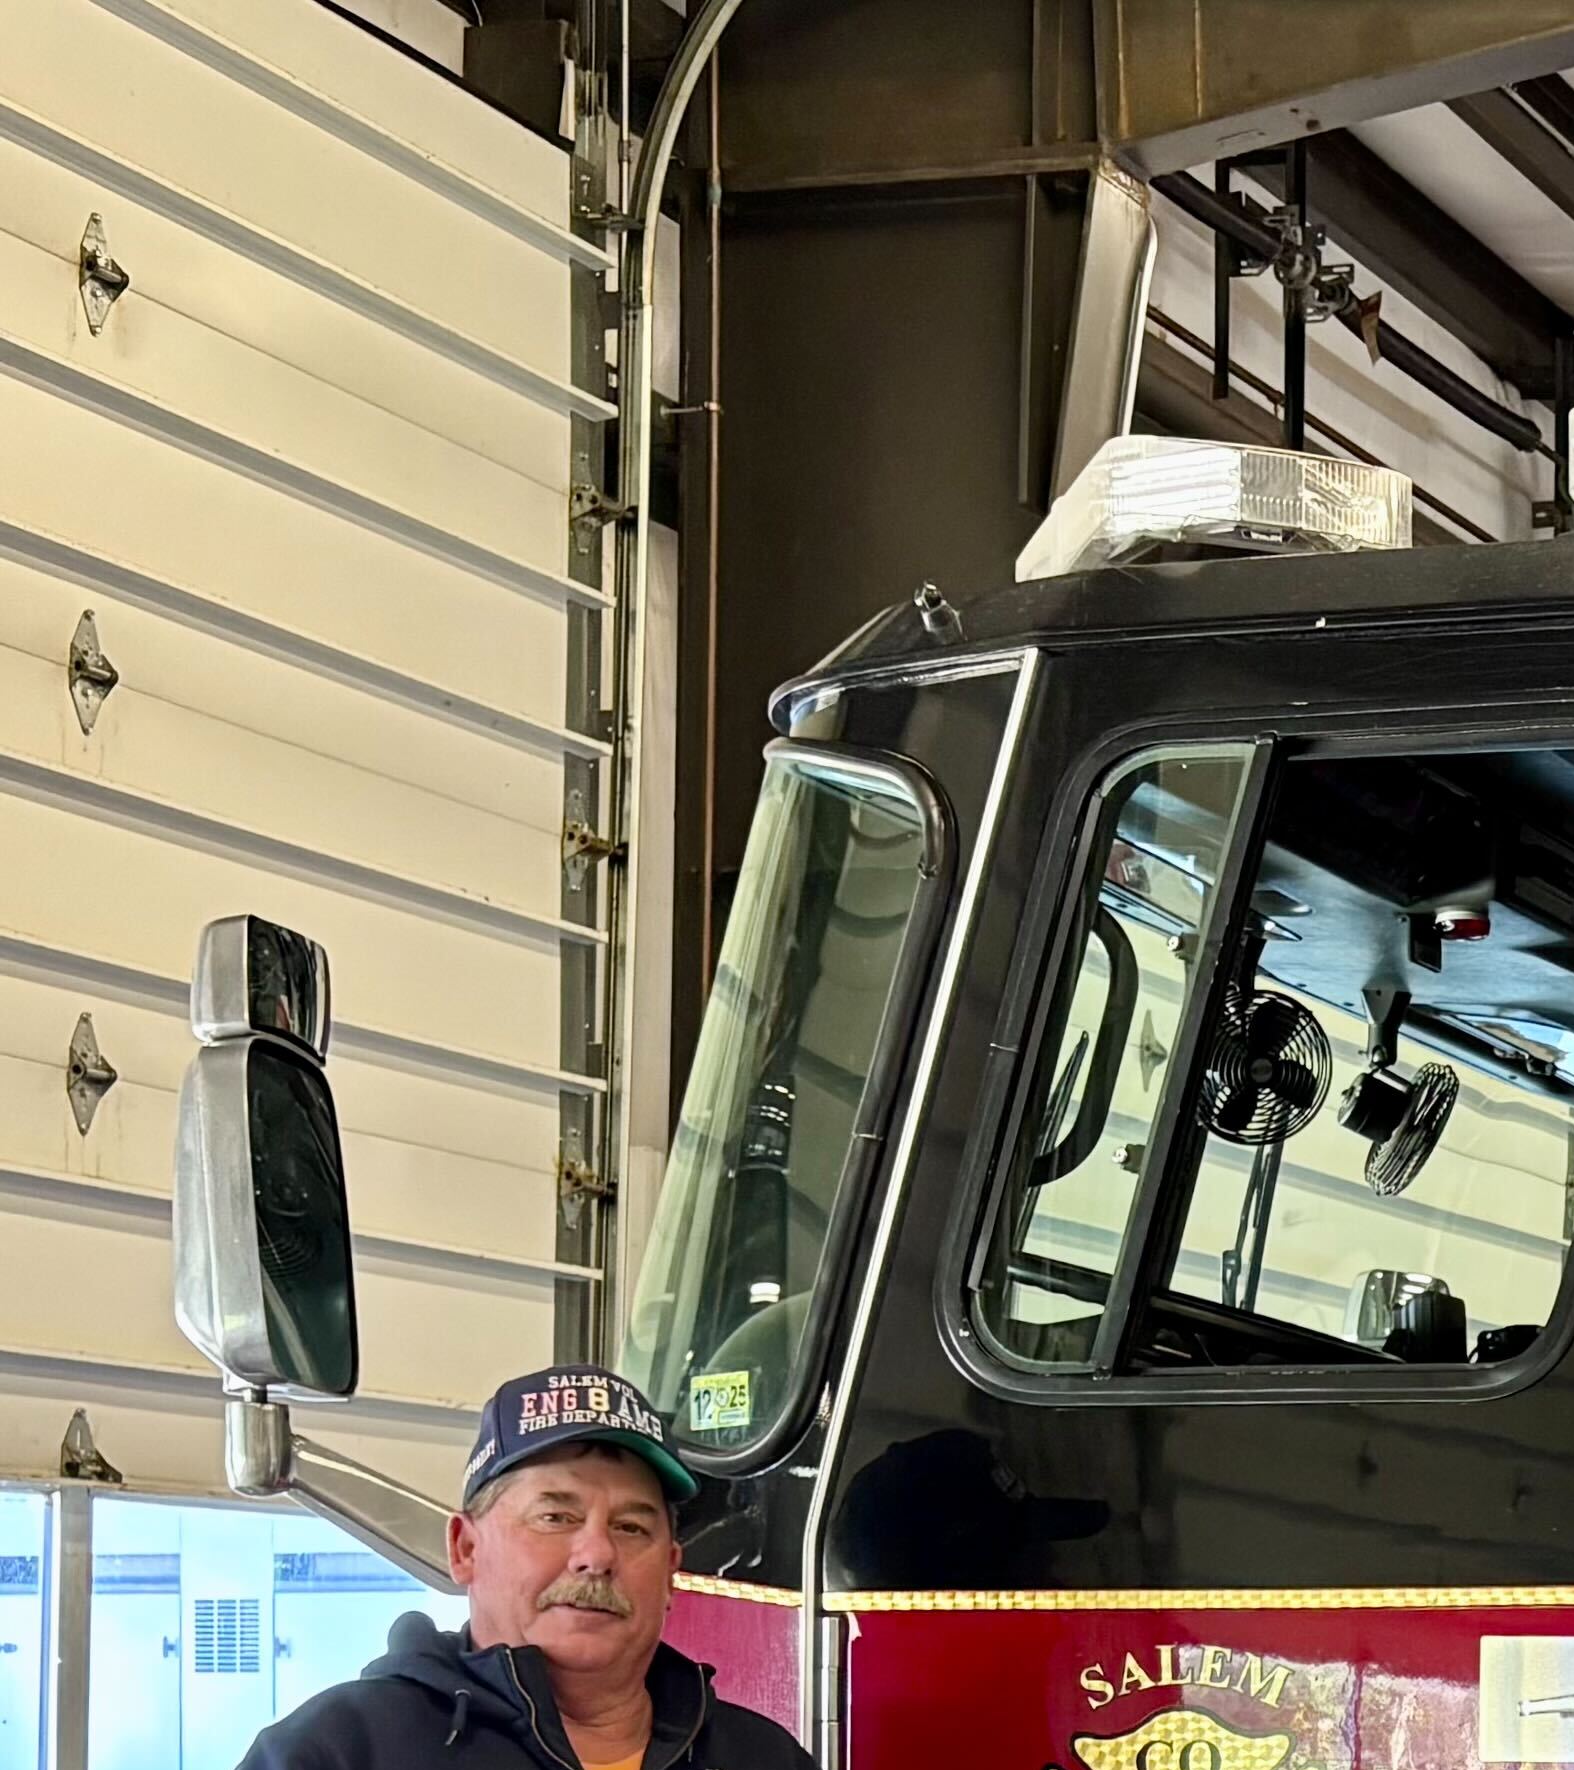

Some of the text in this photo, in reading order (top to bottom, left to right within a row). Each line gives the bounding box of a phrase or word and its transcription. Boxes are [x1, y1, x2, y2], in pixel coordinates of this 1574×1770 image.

[521, 1388, 578, 1418] ENG
[588, 1387, 610, 1412] 8
[548, 1375, 638, 1403] SALEM VOL
[729, 1384, 747, 1408] 25
[694, 1388, 713, 1421] 12
[518, 1413, 559, 1435] FIRE
[1078, 1643, 1296, 1711] SALEM
